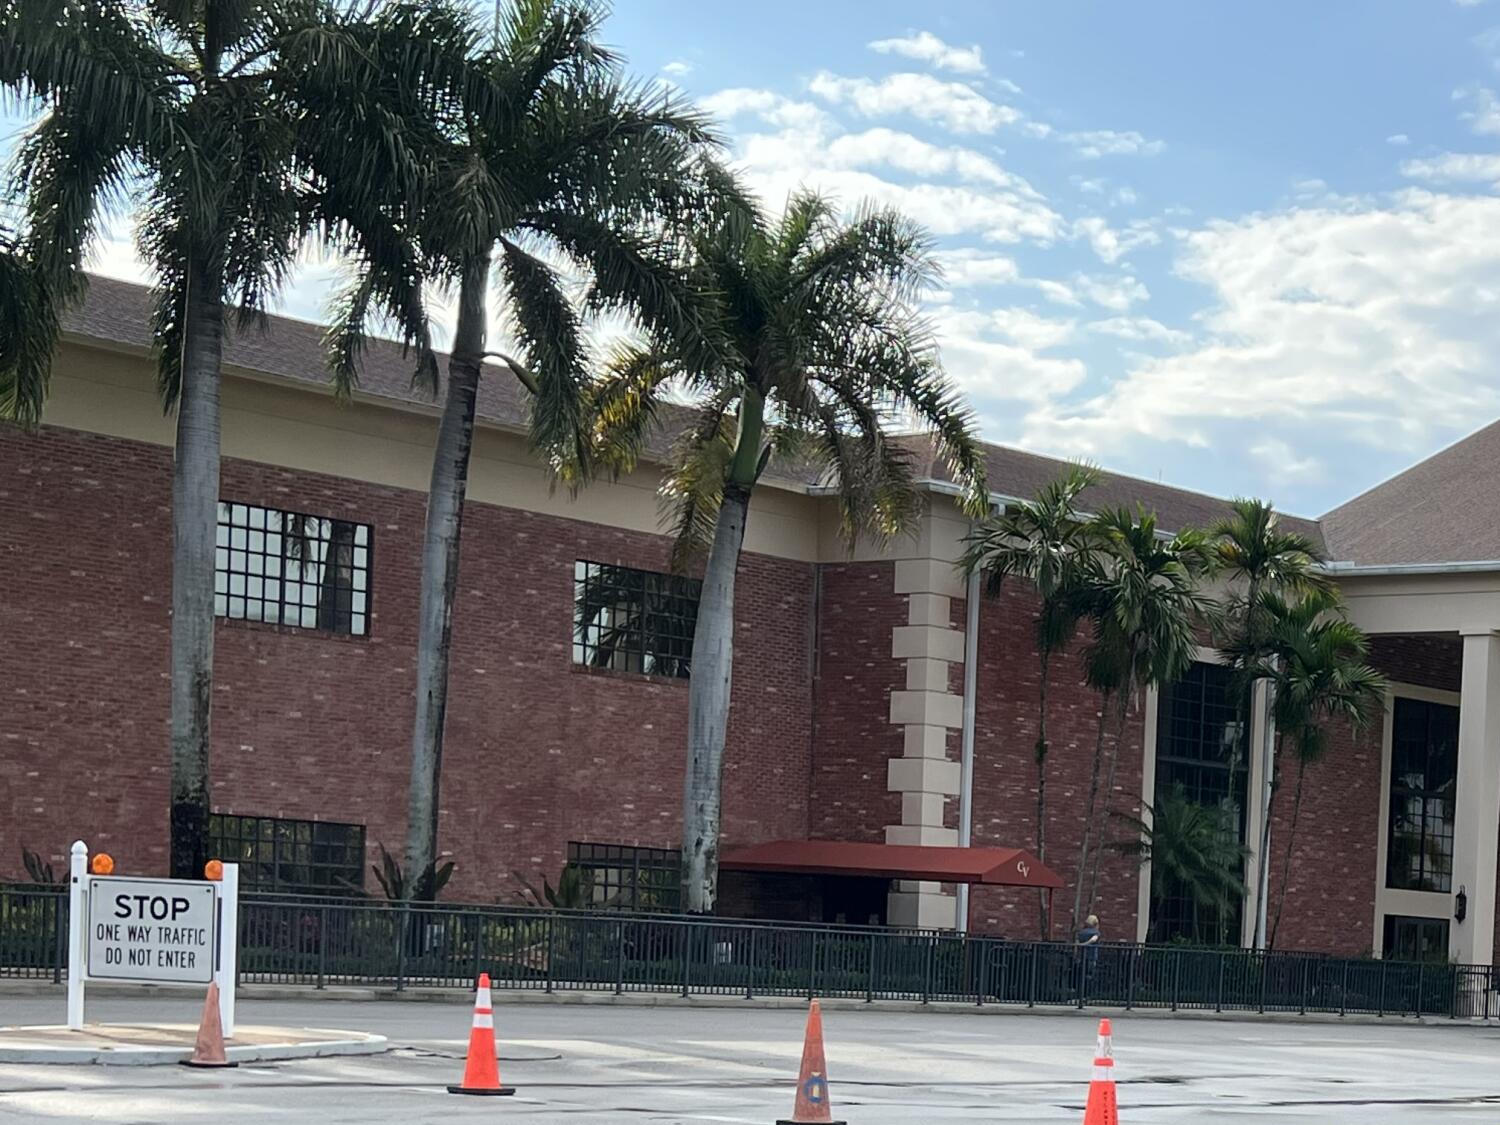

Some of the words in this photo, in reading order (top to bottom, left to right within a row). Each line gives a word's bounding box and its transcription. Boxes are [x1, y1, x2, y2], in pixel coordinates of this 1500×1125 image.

[114, 894, 190, 921] STOP
[96, 923, 121, 941] ONE
[128, 925, 152, 943] WAY
[158, 926, 206, 946] TRAFFIC
[105, 947, 122, 965] DO
[128, 948, 152, 966] NOT
[158, 951, 196, 969] ENTER
